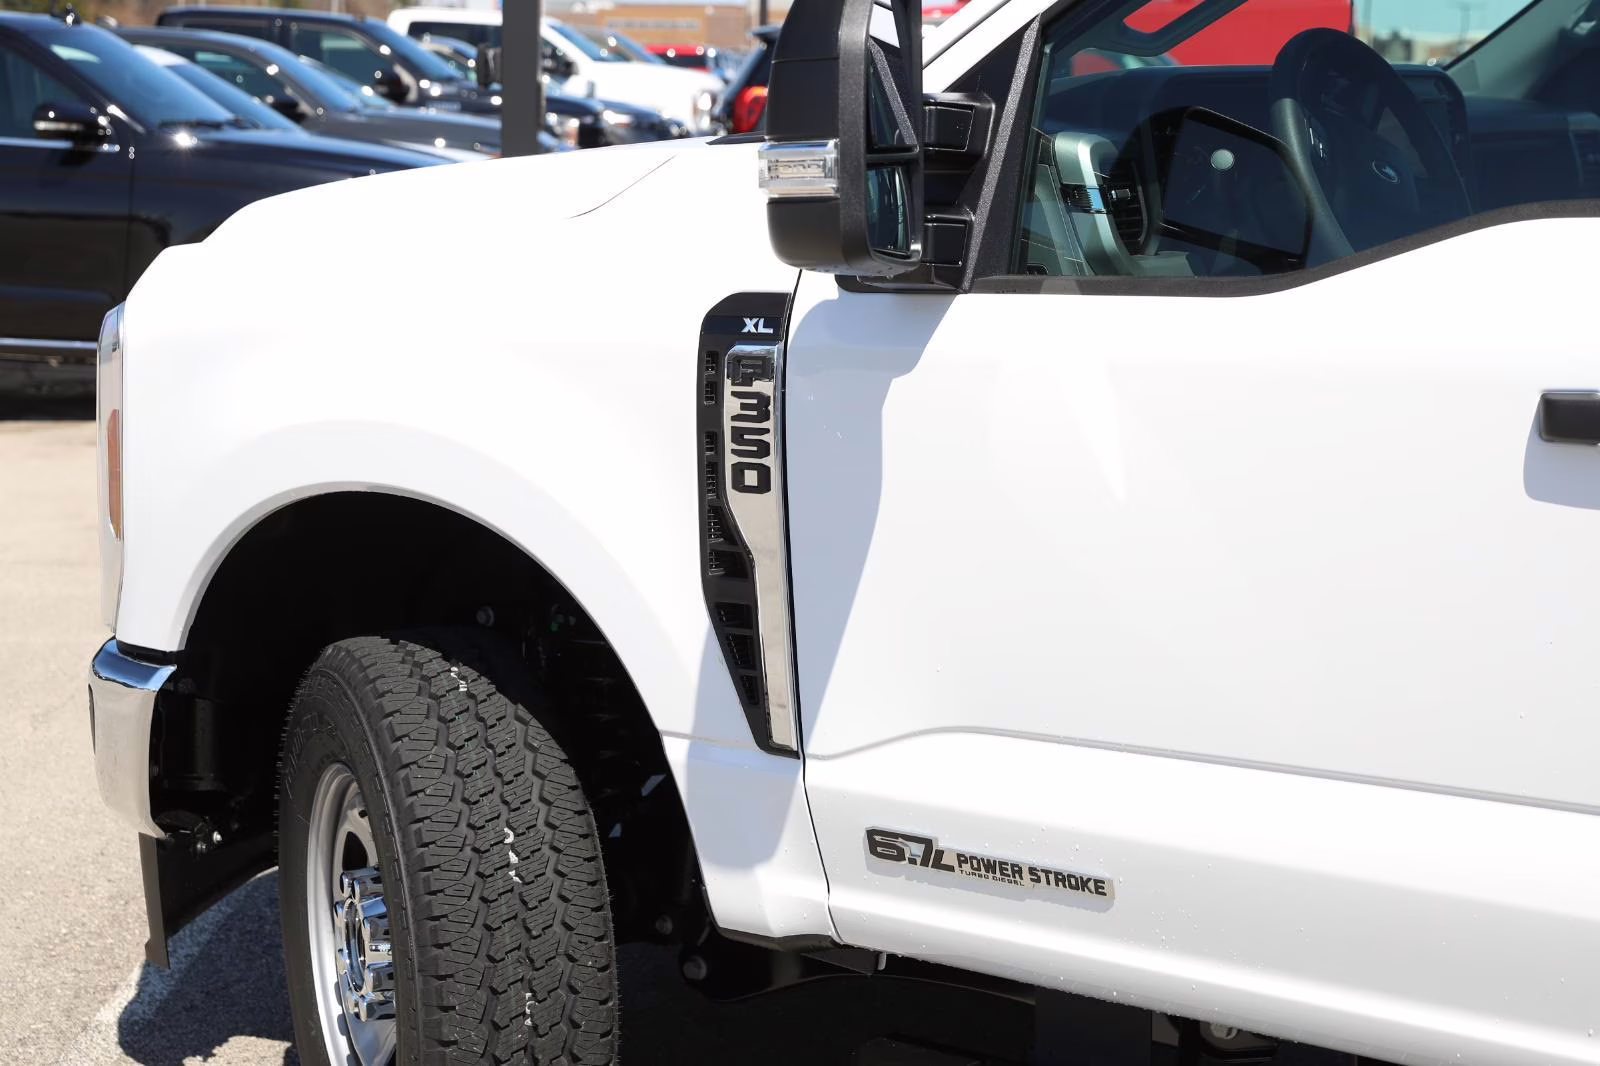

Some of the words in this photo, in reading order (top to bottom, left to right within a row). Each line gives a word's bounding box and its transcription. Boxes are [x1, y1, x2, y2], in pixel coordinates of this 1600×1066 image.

[741, 317, 774, 333] XL
[730, 356, 772, 494] F350
[866, 828, 956, 873] 6.7L
[957, 853, 1024, 880] POWER
[1028, 866, 1108, 896] STROKE
[960, 870, 991, 880] TURBO
[992, 875, 1025, 888] DIESEL
